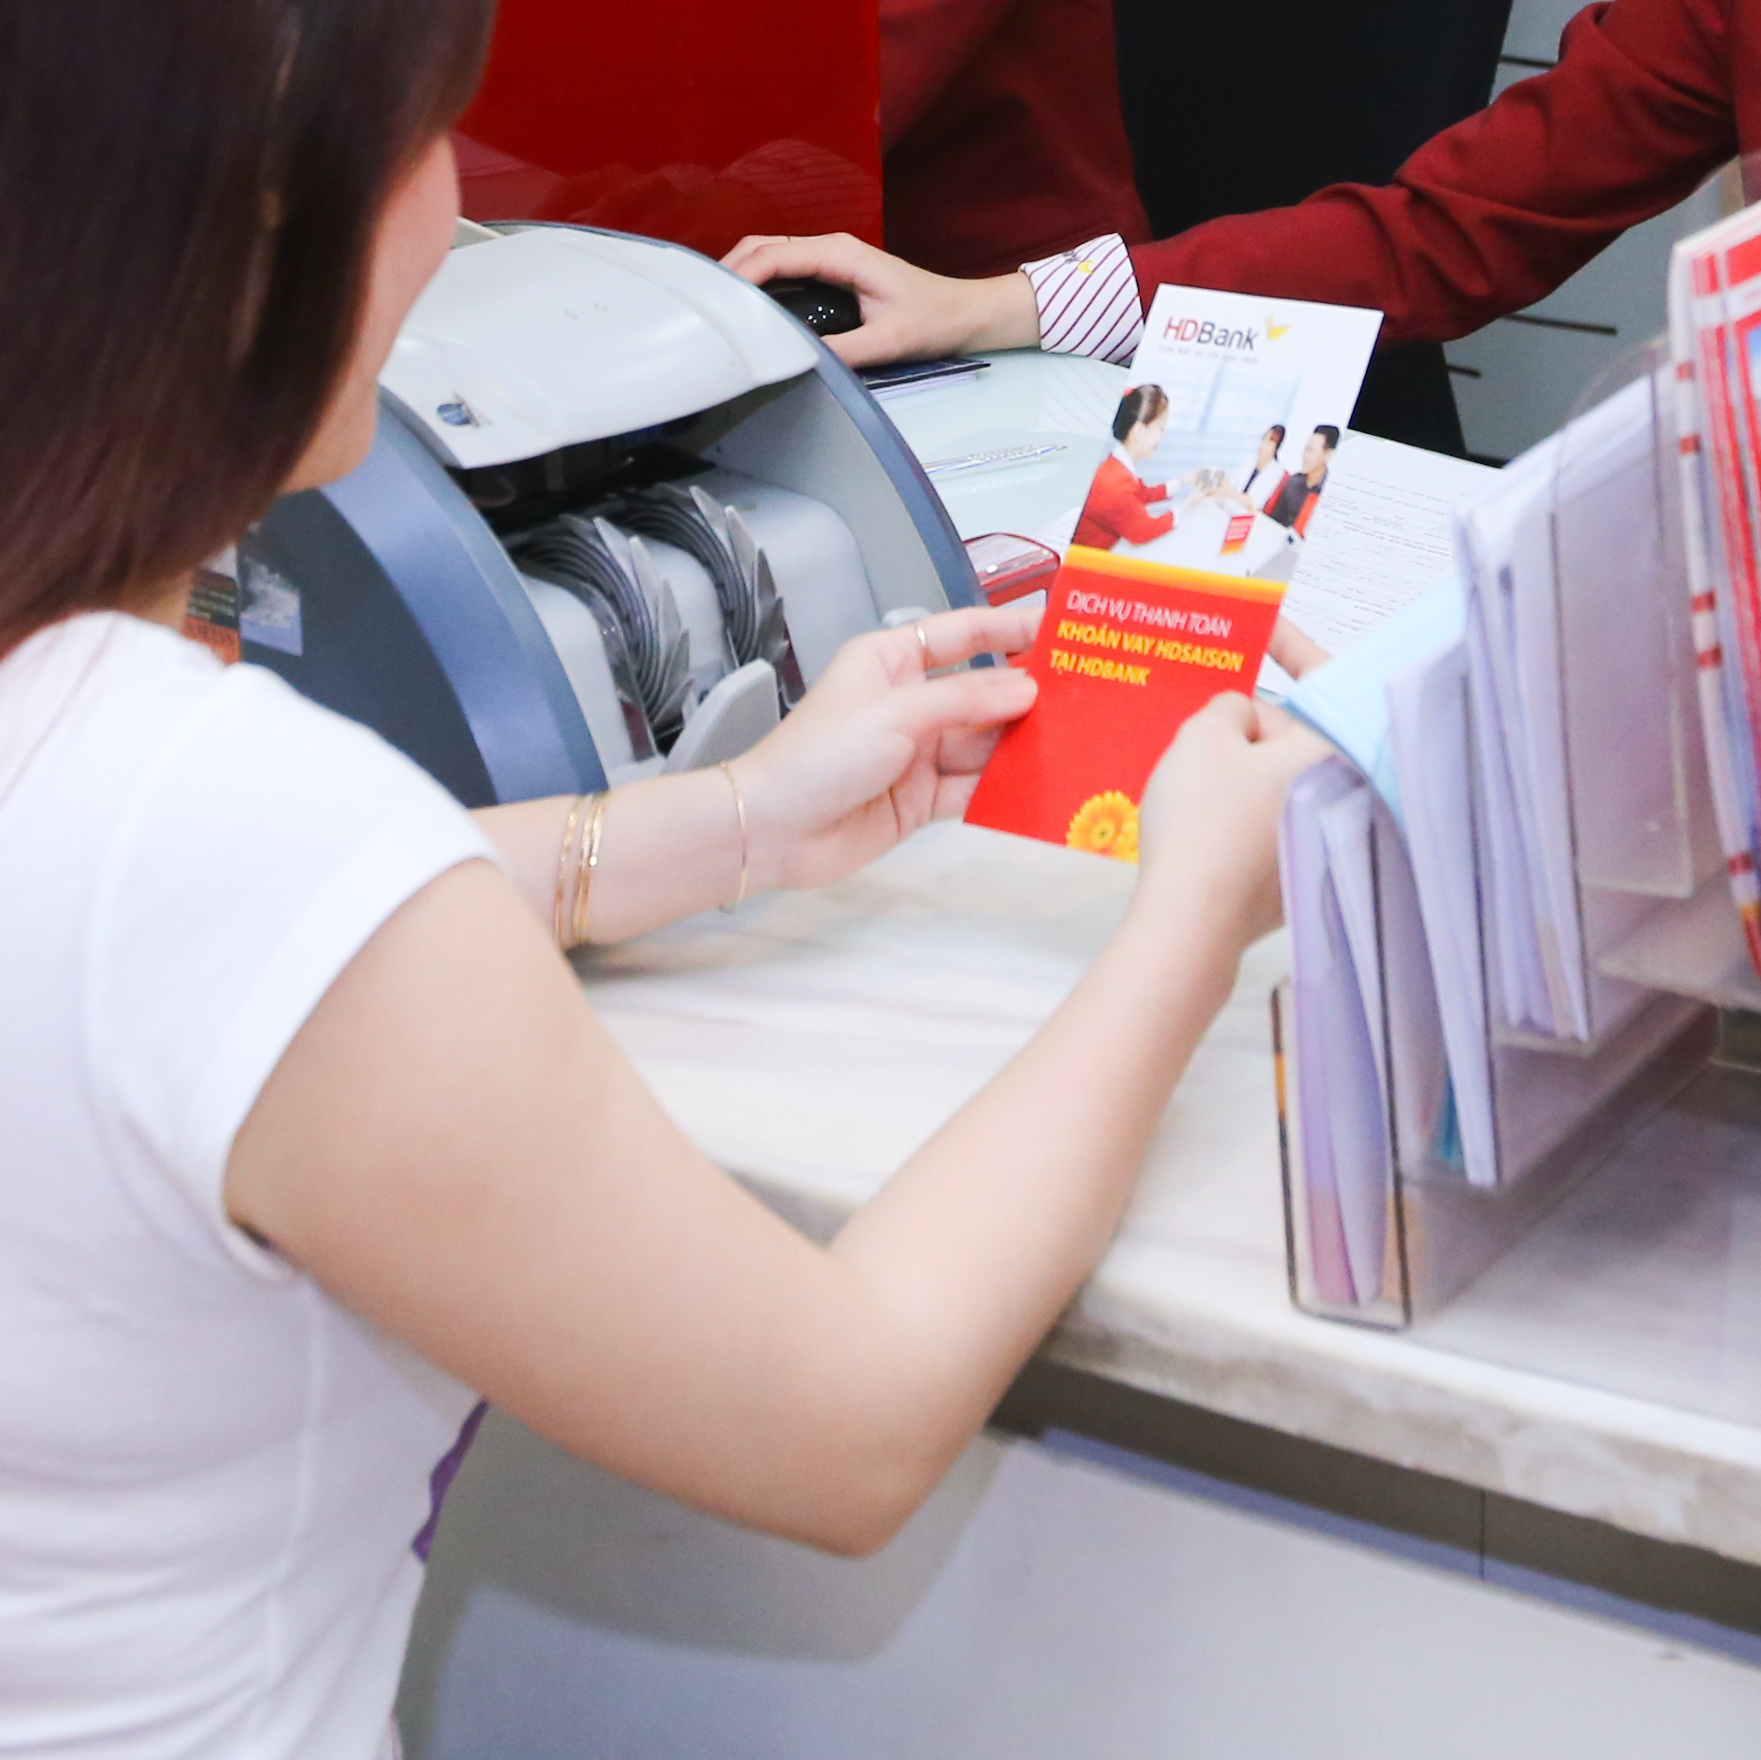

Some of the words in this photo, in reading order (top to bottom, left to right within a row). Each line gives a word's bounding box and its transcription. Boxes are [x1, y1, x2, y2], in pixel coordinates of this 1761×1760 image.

[1163, 317, 1260, 351] HDBank
[1066, 590, 1108, 615] DỊCH
[1132, 603, 1189, 630] THANH
[1078, 657, 1150, 686] HDBANK
[1122, 633, 1156, 656] VAY
[1155, 638, 1244, 673] HDSAISON
